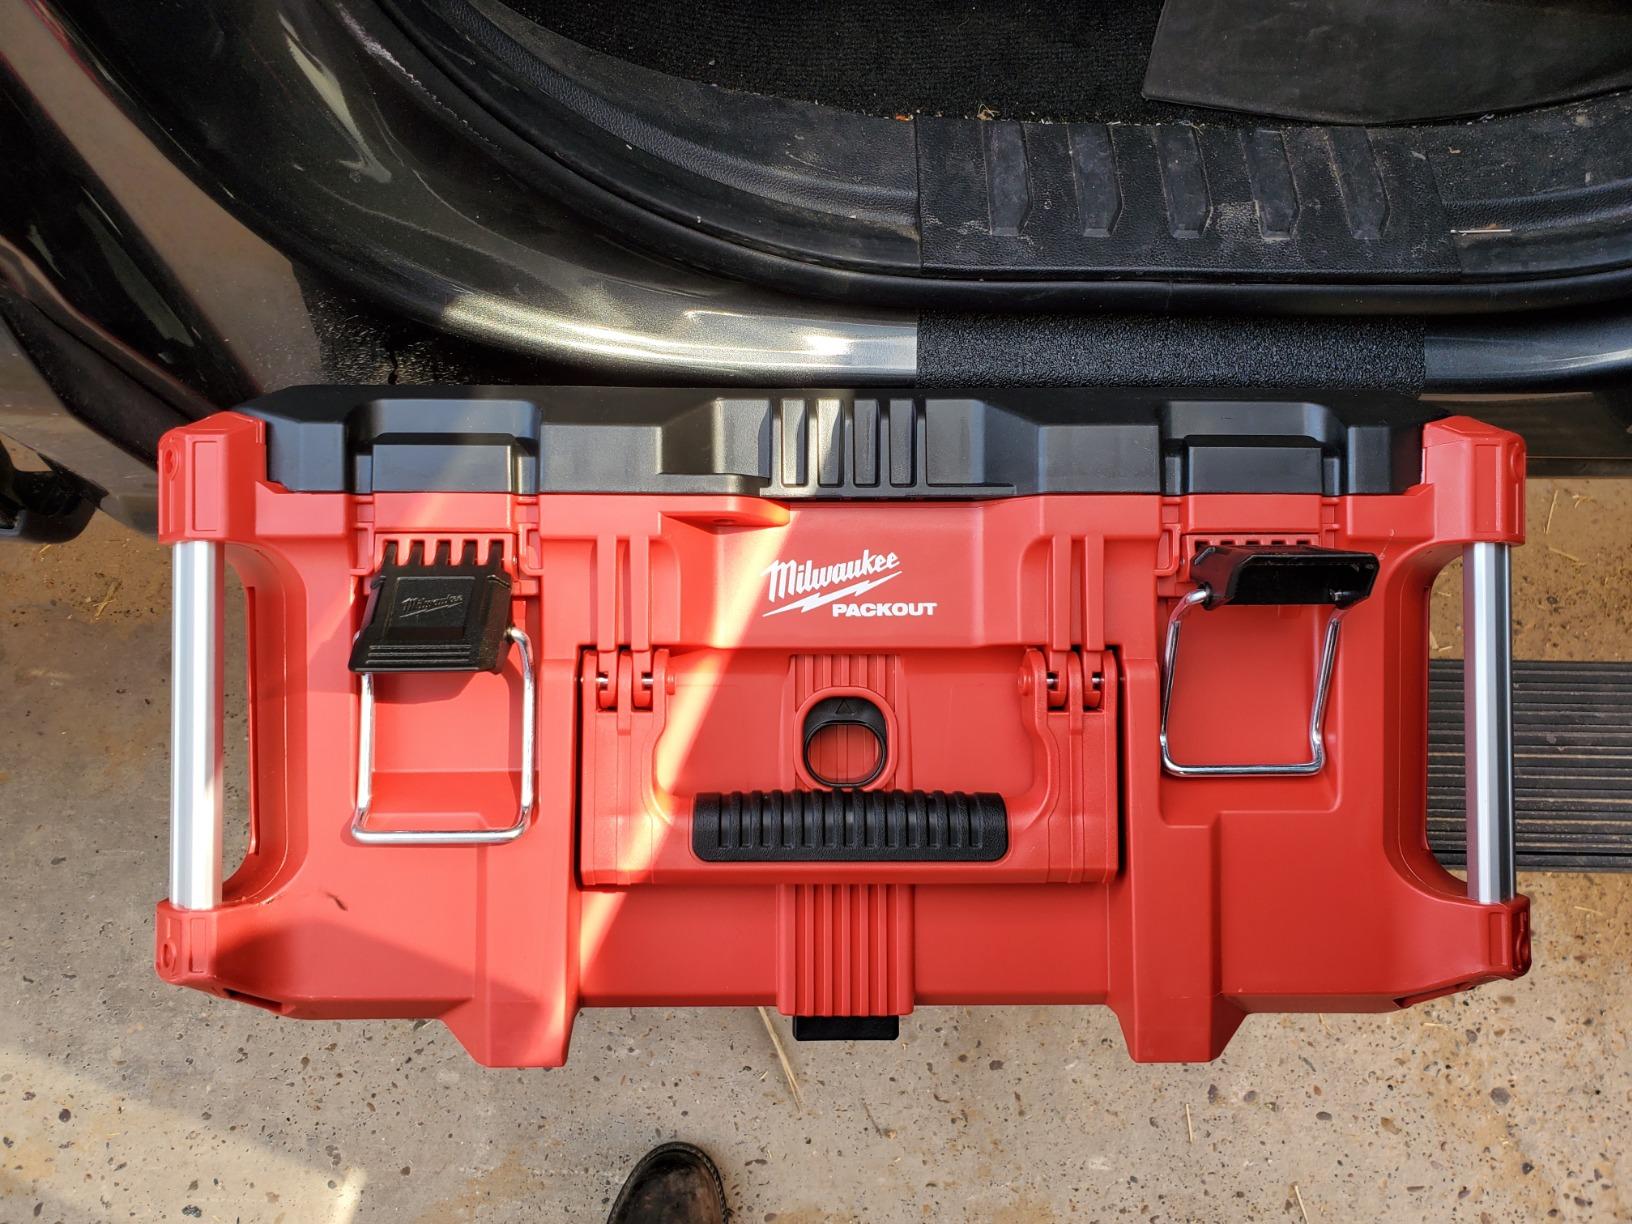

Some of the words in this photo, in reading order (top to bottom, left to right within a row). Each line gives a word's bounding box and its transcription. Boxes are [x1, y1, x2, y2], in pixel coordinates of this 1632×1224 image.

[760, 549, 900, 602] Milwaukee
[401, 594, 463, 611] Milwaukee
[832, 602, 938, 617] PACKOUT
